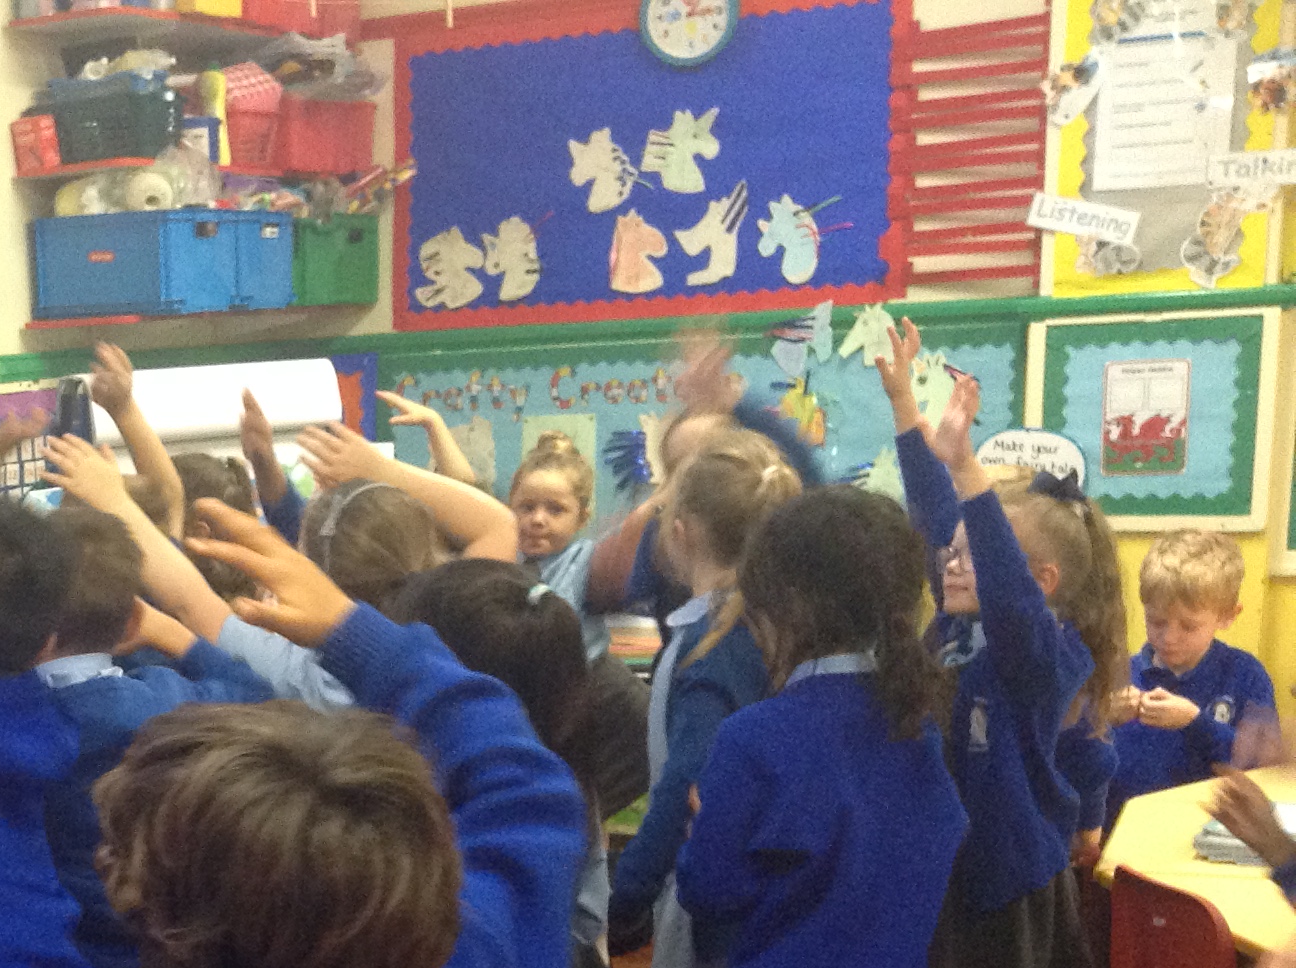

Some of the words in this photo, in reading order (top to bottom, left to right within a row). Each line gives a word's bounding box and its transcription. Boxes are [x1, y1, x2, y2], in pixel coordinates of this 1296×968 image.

[1036, 198, 1132, 240] Listening
[992, 439, 1024, 452] Make
[1031, 443, 1059, 459] your
